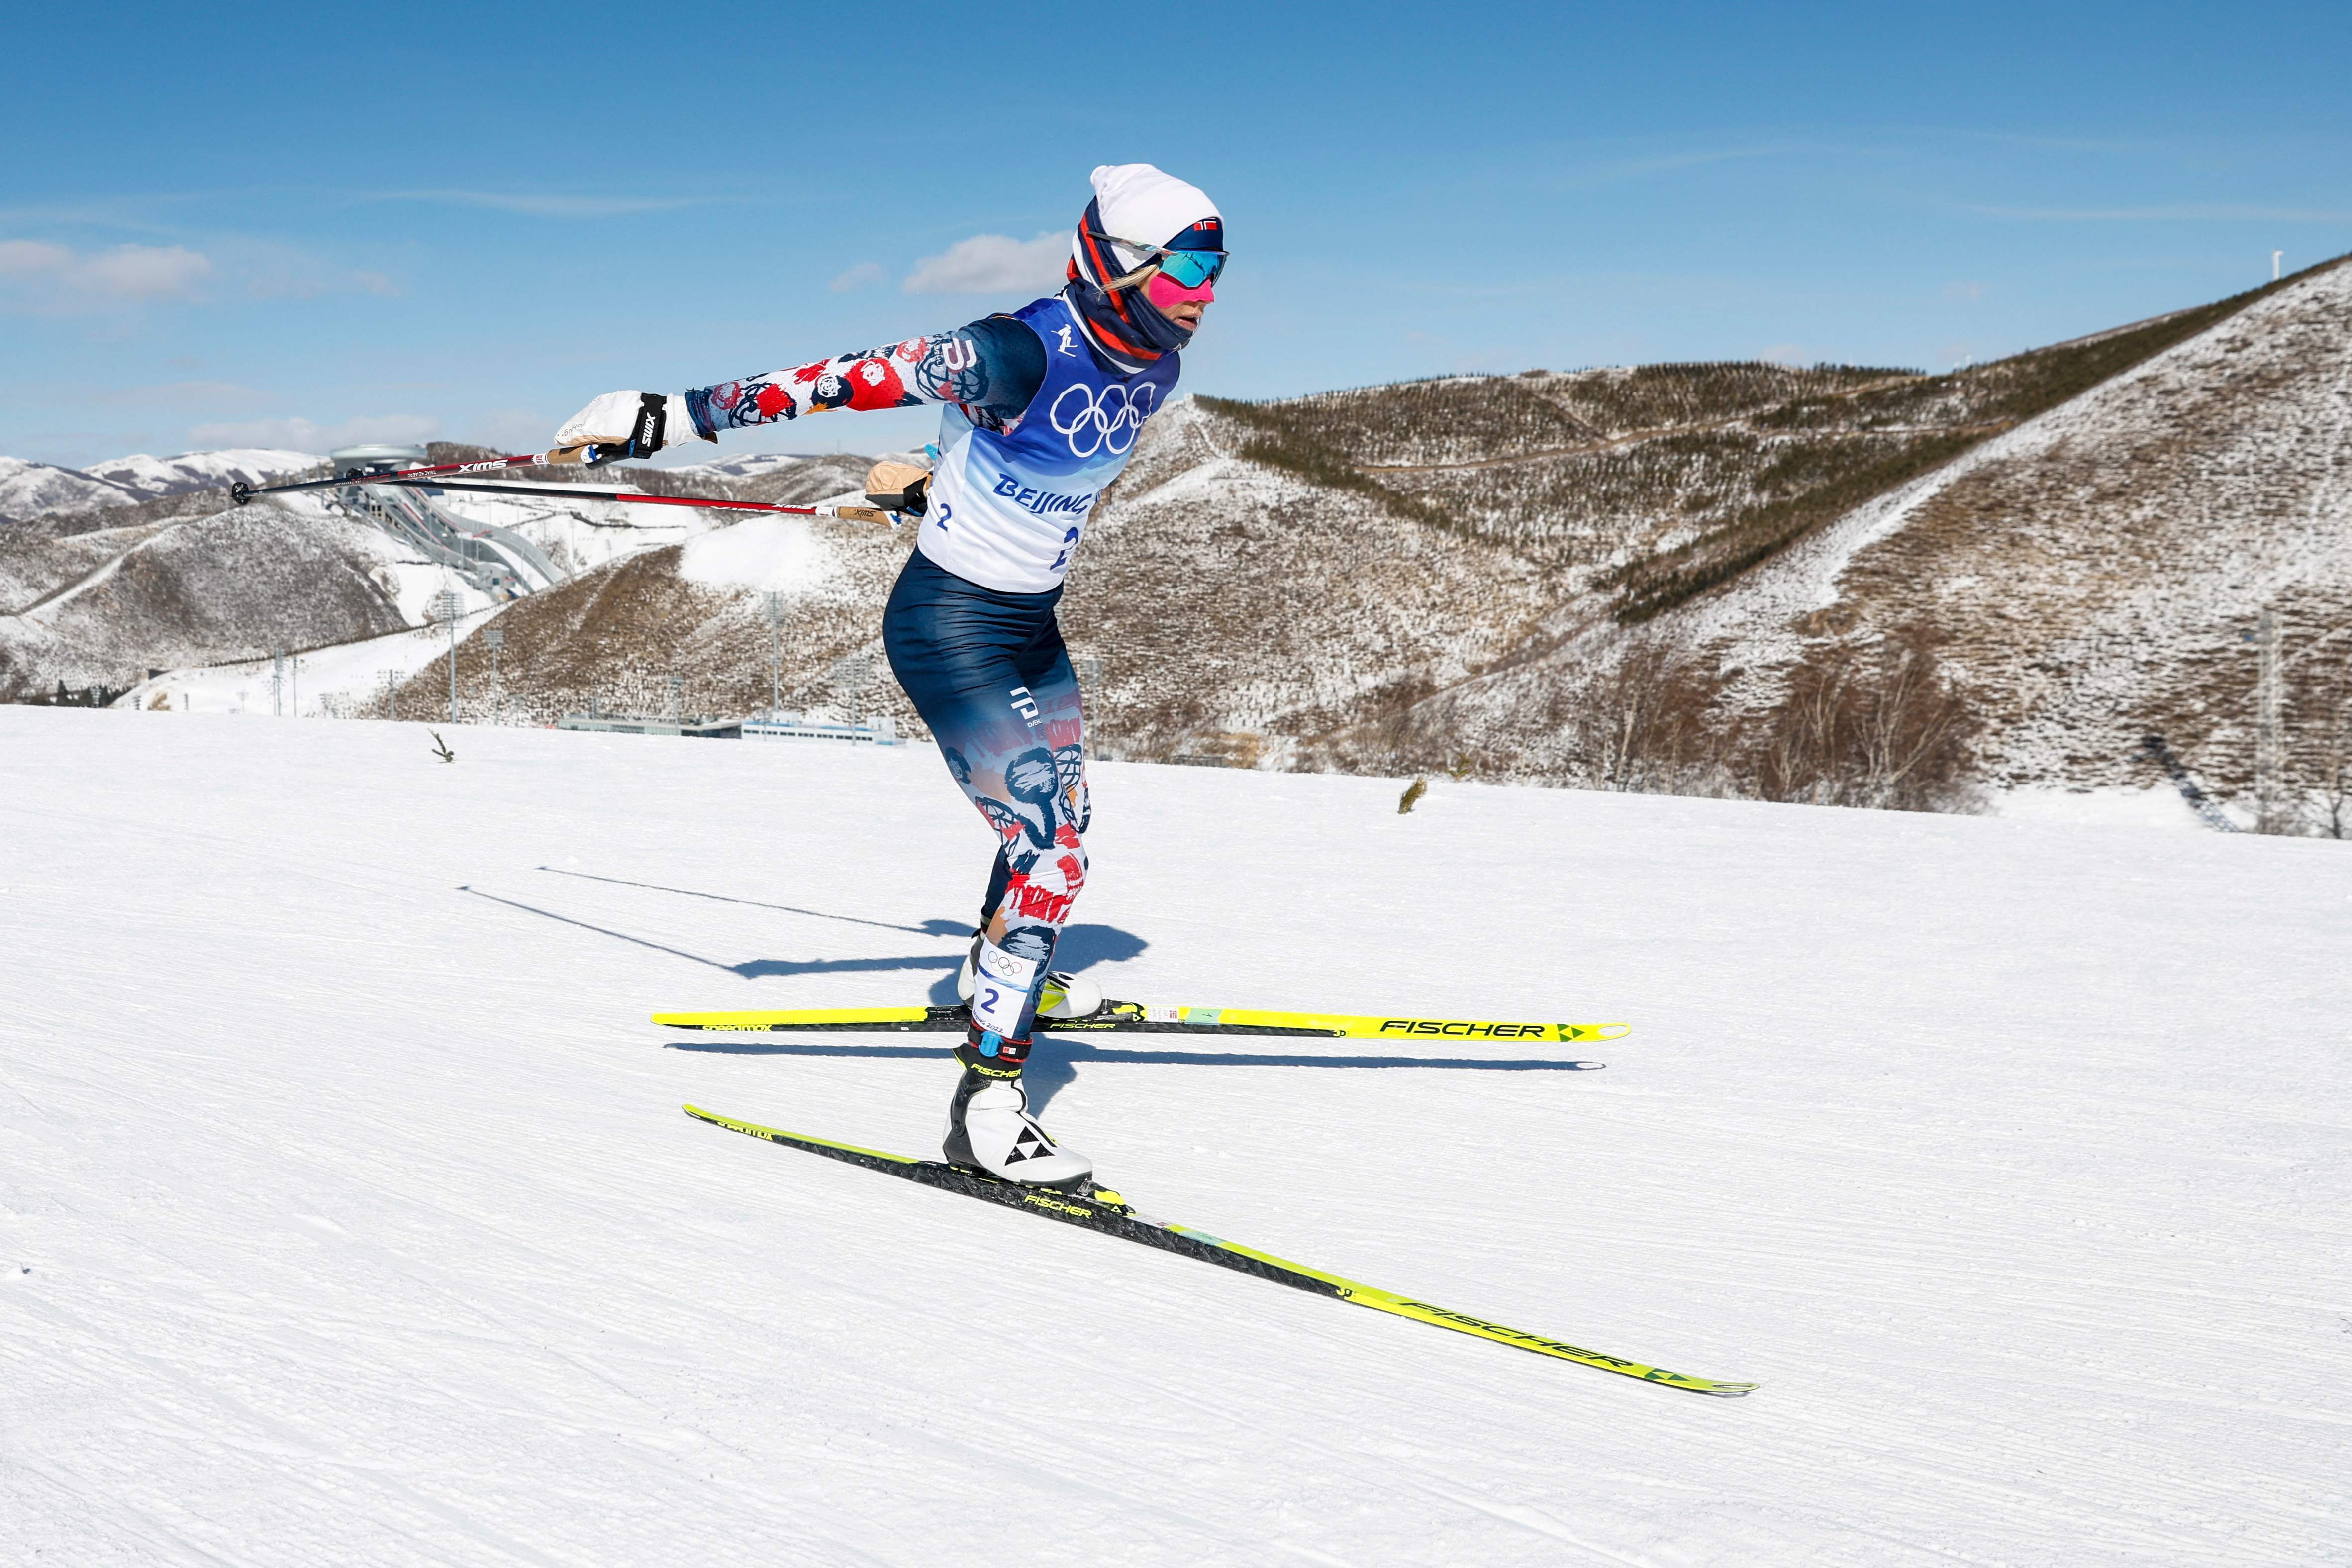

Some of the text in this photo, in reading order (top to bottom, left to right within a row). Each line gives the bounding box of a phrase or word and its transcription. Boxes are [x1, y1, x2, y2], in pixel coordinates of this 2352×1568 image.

[642, 412, 656, 447] SWIX
[457, 459, 508, 473] SWIX
[993, 473, 1092, 514] BEIJING
[937, 503, 951, 532] 2
[1050, 527, 1078, 571] 2
[981, 988, 999, 1014] 2
[987, 1023, 1003, 1033] 2022
[1380, 1020, 1545, 1038] FISCHER
[971, 1063, 1021, 1078] FISCHER
[1024, 1195, 1092, 1219] FISCHER
[1398, 1302, 1634, 1368] FISCHER
